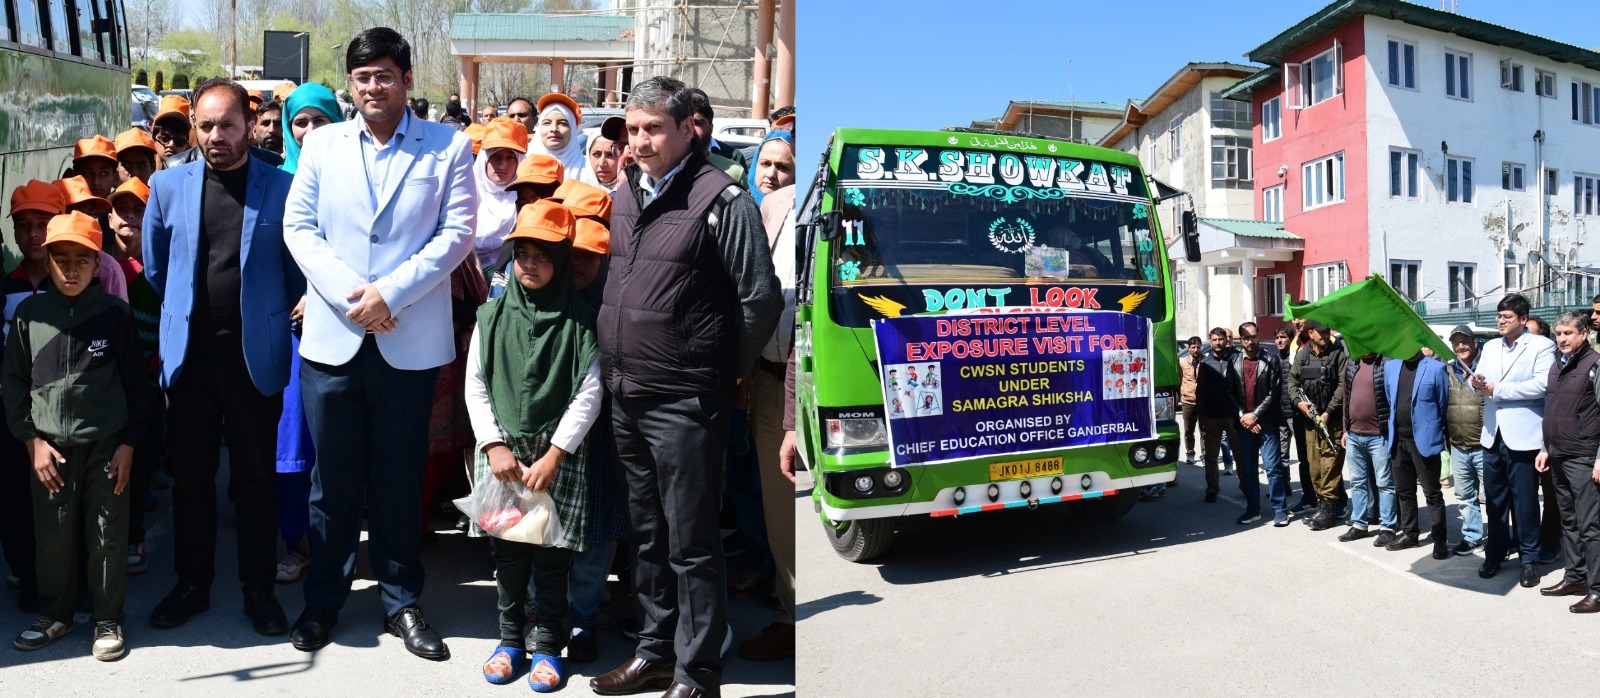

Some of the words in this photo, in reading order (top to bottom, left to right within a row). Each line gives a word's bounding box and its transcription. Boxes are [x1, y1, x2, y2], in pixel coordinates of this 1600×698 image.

[842, 219, 866, 245] 11
[922, 287, 1012, 312] DONT
[1030, 287, 1102, 309] LOOK
[936, 317, 1030, 337] DISTRICT
[1035, 315, 1096, 334] LEVEL
[91, 339, 108, 347] NIKE
[906, 338, 1029, 362] EXPOSURE
[1033, 336, 1084, 356] VISIT
[1089, 334, 1128, 352] FOR
[959, 363, 1006, 378] CWSN
[1009, 359, 1085, 376] STUDENTS
[999, 378, 1050, 392] UNDER
[952, 396, 1029, 413] SAMAGRA
[1032, 391, 1094, 407] SHIKSHA
[975, 417, 1052, 433] ORGANISED
[1056, 414, 1072, 427] BY
[896, 441, 936, 456] CHIEF
[940, 434, 1016, 452] EDUCATION
[1019, 428, 1065, 445] OFFICE
[1068, 422, 1139, 440] GANDERBAL
[999, 462, 1031, 476] JK01J
